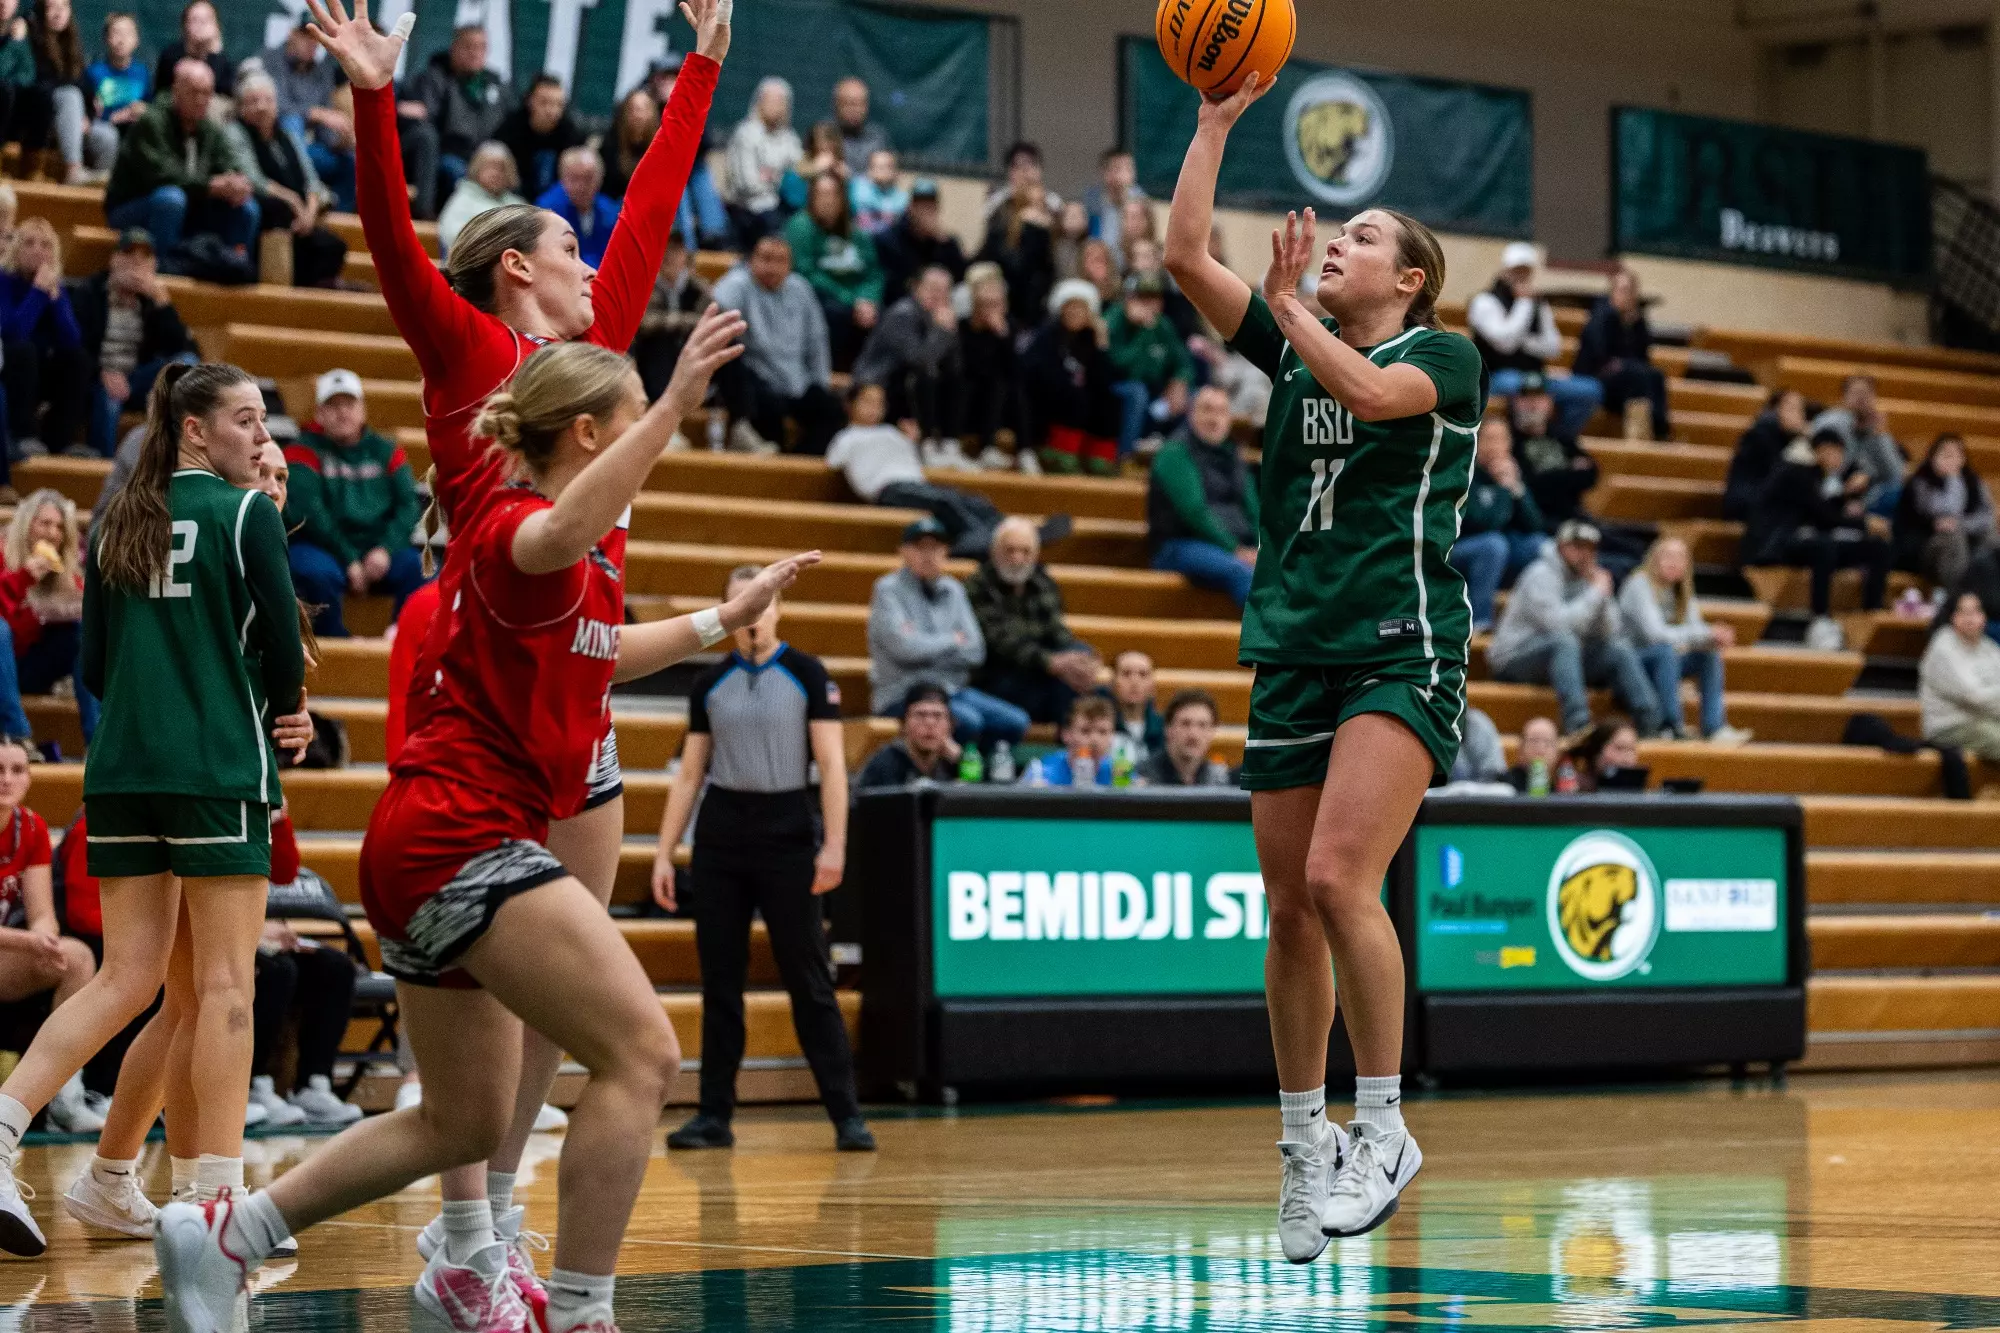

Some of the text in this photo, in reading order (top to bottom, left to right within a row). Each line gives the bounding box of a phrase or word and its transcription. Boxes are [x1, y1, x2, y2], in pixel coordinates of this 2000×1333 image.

[1302, 398, 1354, 445] BSU
[1300, 458, 1346, 532] 11
[1406, 622, 1415, 631] M
[948, 871, 1270, 940] BEMIDJI ST
